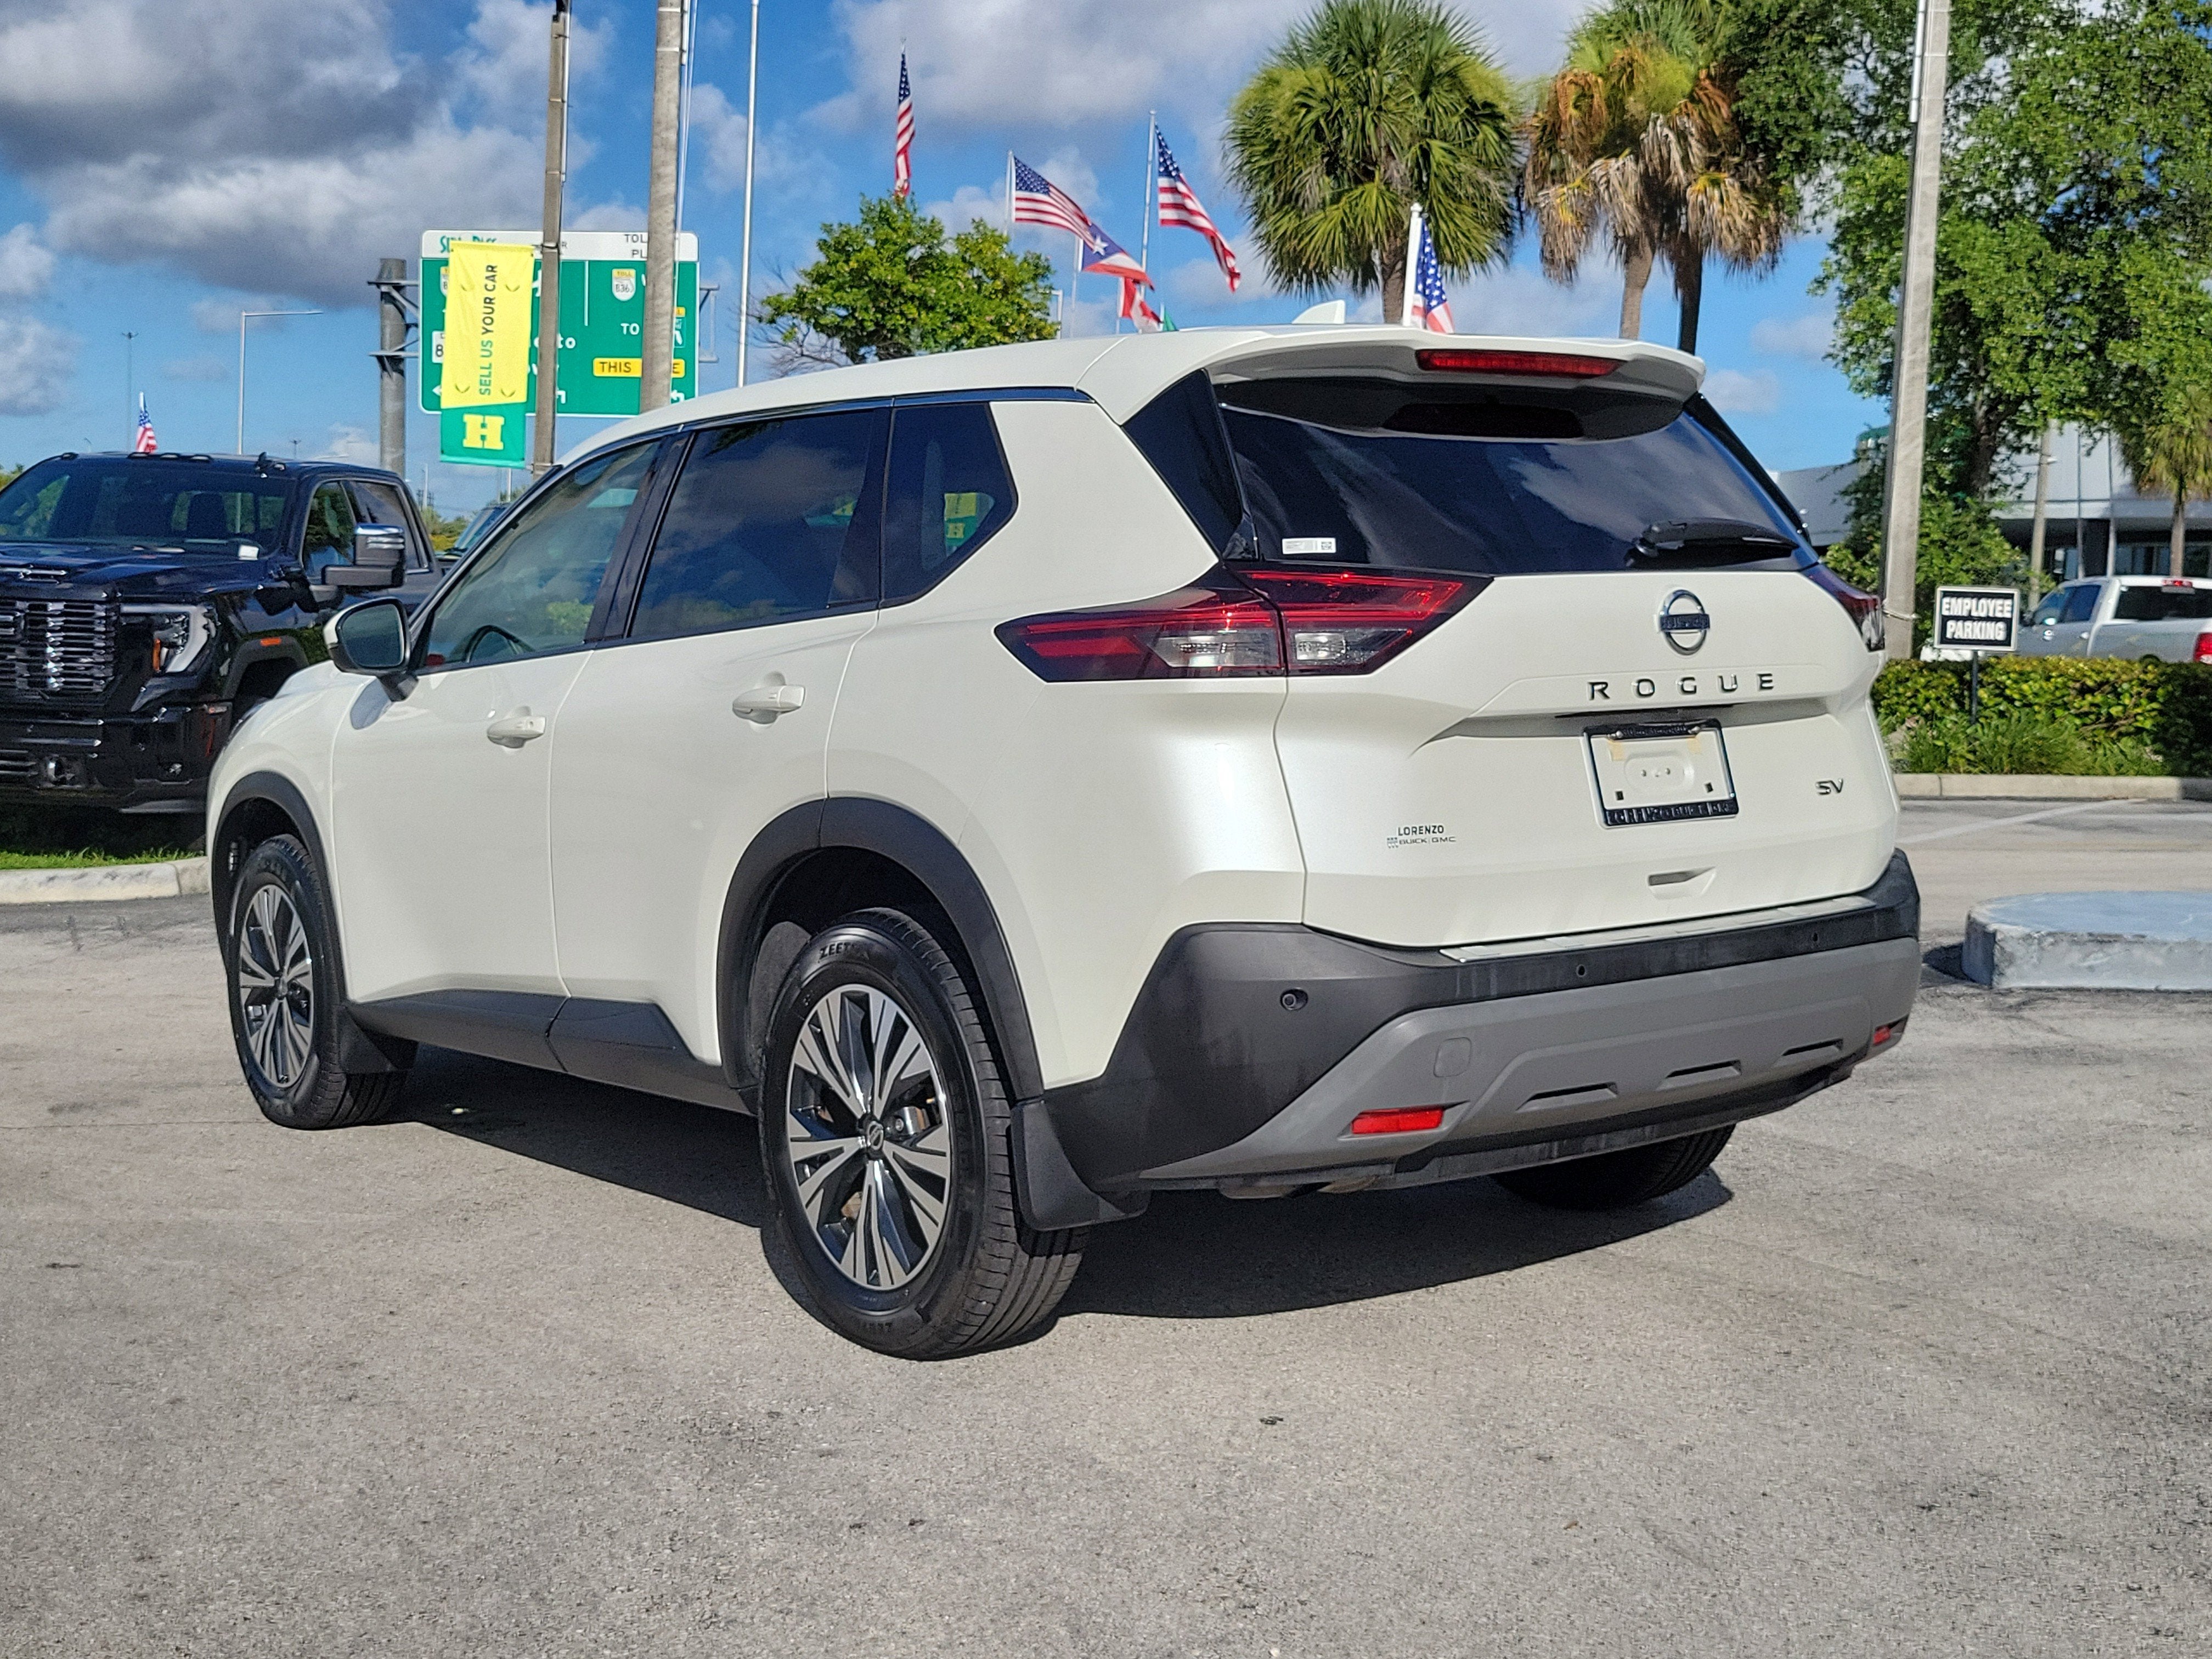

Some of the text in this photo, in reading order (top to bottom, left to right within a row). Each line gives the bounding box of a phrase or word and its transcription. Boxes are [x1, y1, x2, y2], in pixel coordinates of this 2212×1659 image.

[479, 264, 498, 396] SELL US YOUR CAR
[620, 323, 640, 335] TO
[599, 361, 632, 374] THIS
[462, 414, 505, 450] H
[1942, 597, 2012, 618] EMPLOYEE
[1945, 619, 2007, 641] PARKING
[1588, 673, 1774, 701] ROGUE
[1815, 778, 1844, 795] SV
[1397, 825, 1444, 836] LORENZO
